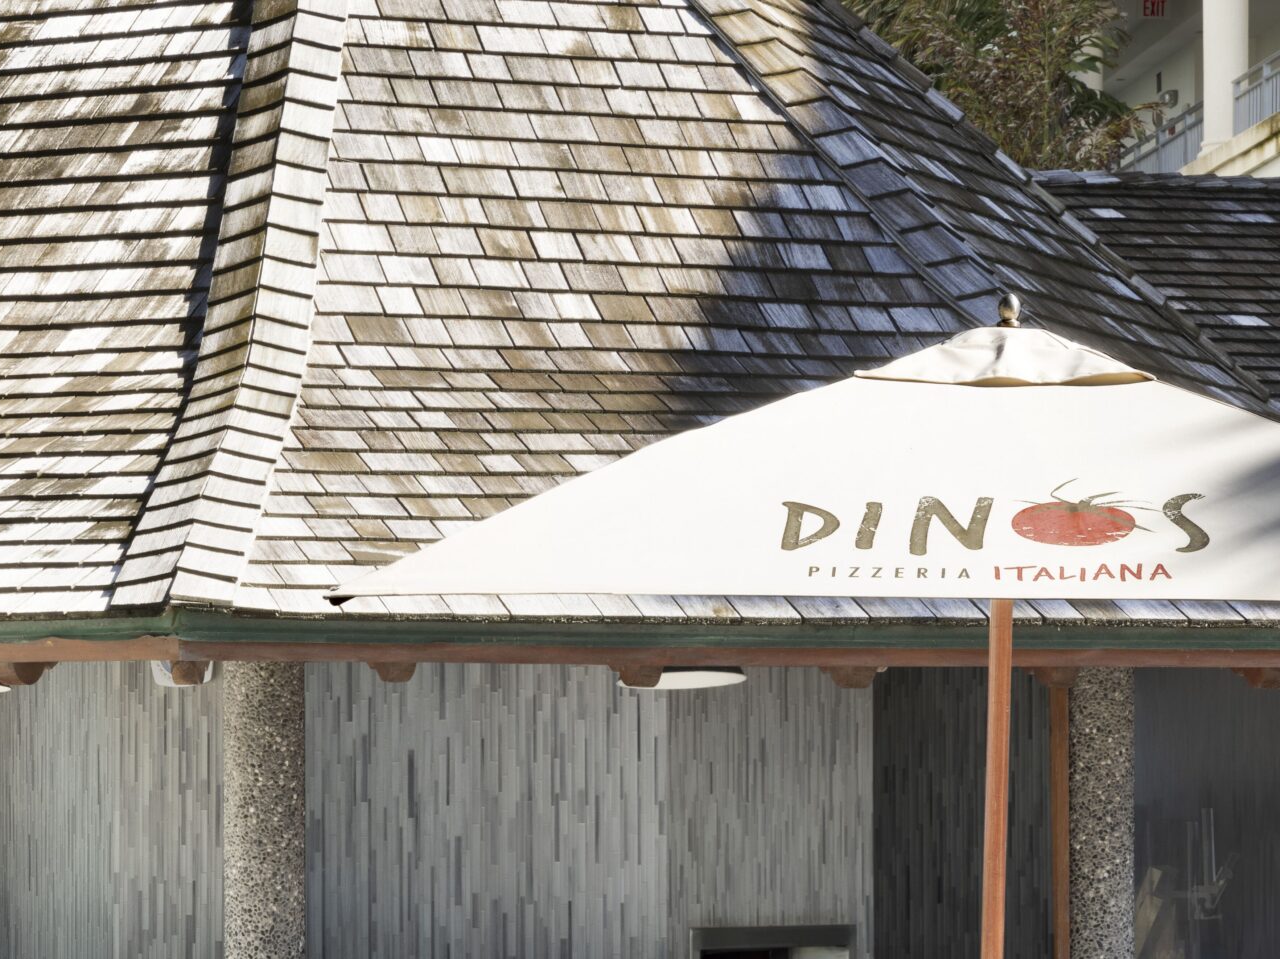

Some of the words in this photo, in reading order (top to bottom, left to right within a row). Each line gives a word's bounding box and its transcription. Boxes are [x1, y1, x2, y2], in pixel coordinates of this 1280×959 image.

[1143, 0, 1166, 16] EXIT
[807, 566, 971, 579] PIZZERIA
[993, 563, 1173, 582] ITALIANA
